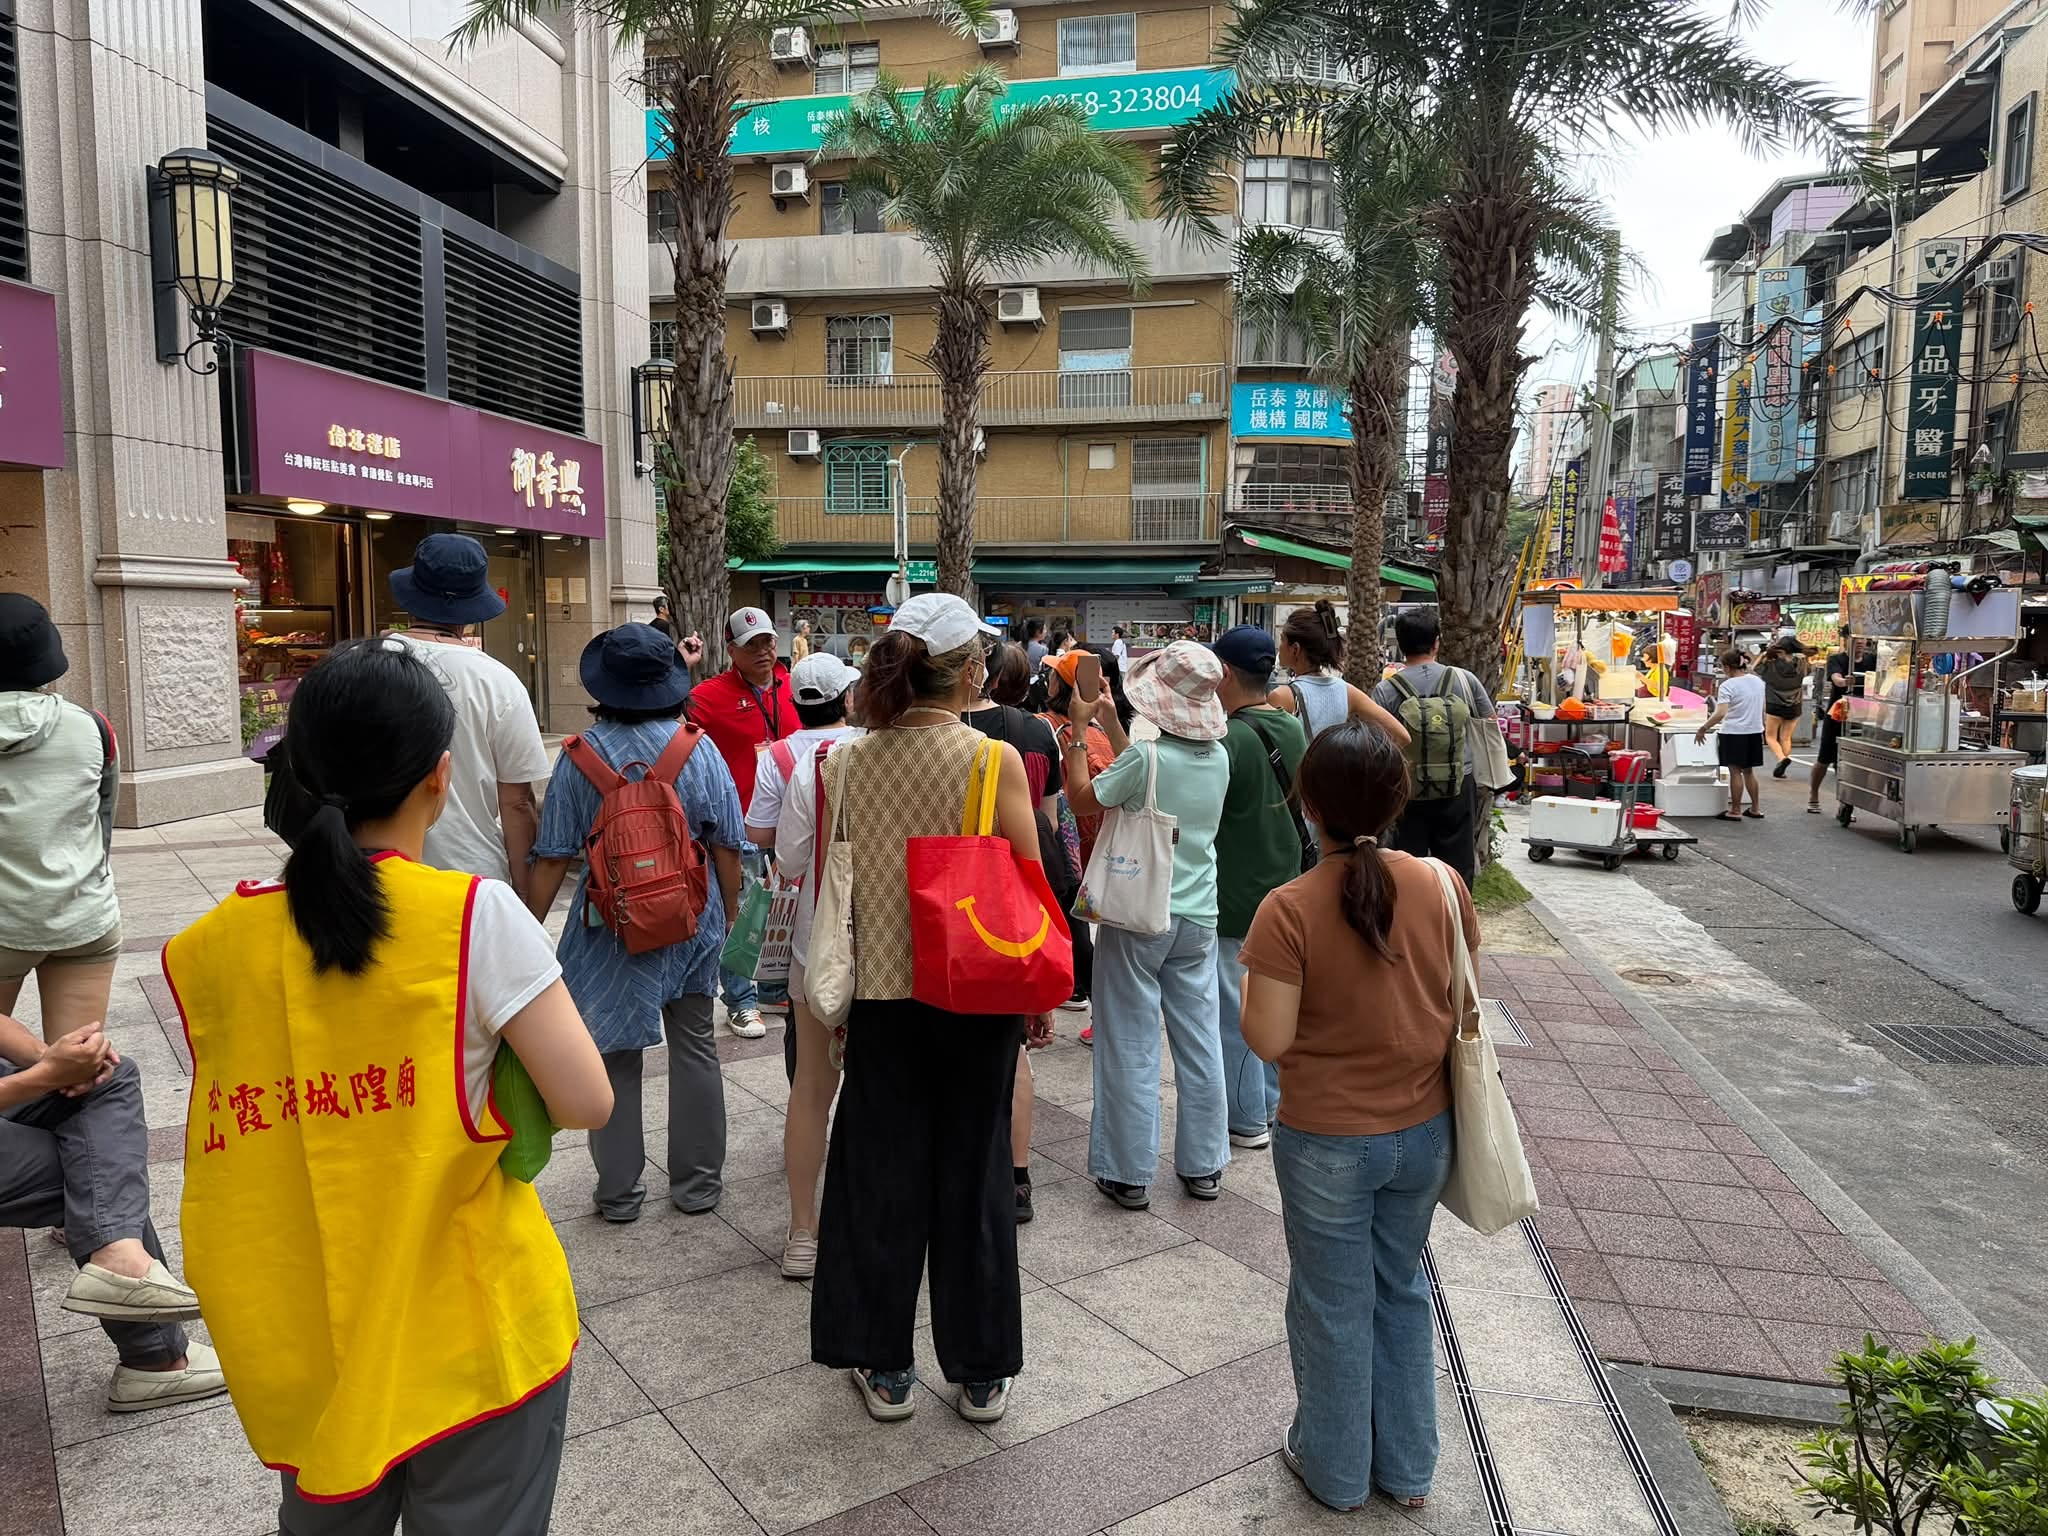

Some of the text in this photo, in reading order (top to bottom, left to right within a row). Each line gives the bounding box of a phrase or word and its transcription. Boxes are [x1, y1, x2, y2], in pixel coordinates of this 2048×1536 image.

[1763, 271, 1789, 282] 24H
[1250, 388, 1287, 408] 岳泰
[1249, 409, 1286, 429] 機構
[1294, 410, 1328, 429] 國際
